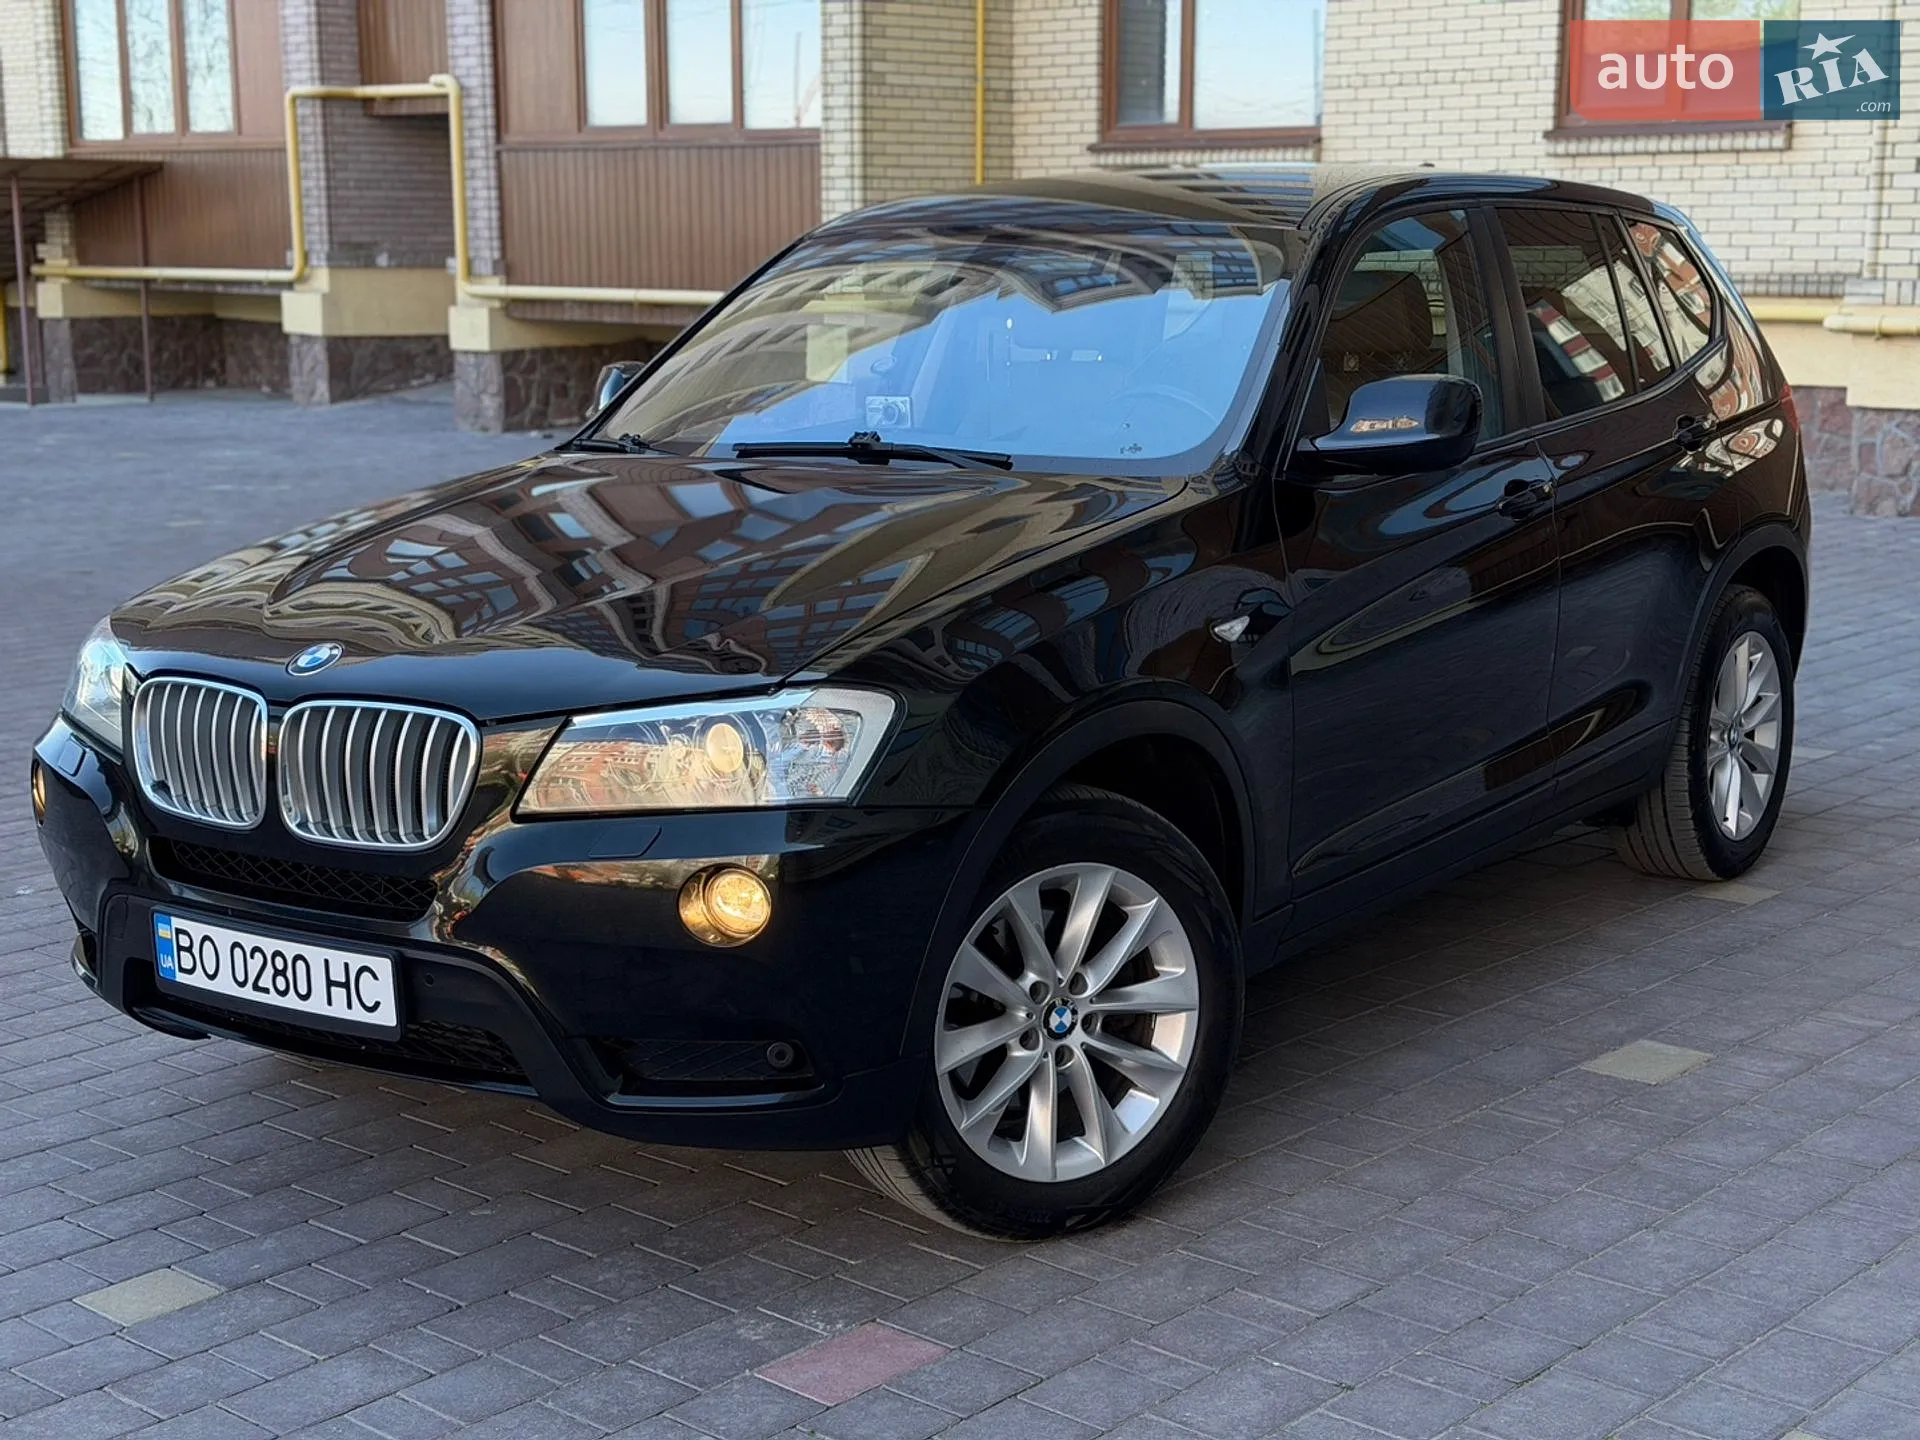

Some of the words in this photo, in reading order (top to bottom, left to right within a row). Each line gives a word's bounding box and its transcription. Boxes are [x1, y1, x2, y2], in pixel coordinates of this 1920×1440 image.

[159, 953, 175, 970] UA
[174, 927, 220, 981] BO
[230, 941, 312, 1001] 0280
[323, 958, 381, 1013] HC
